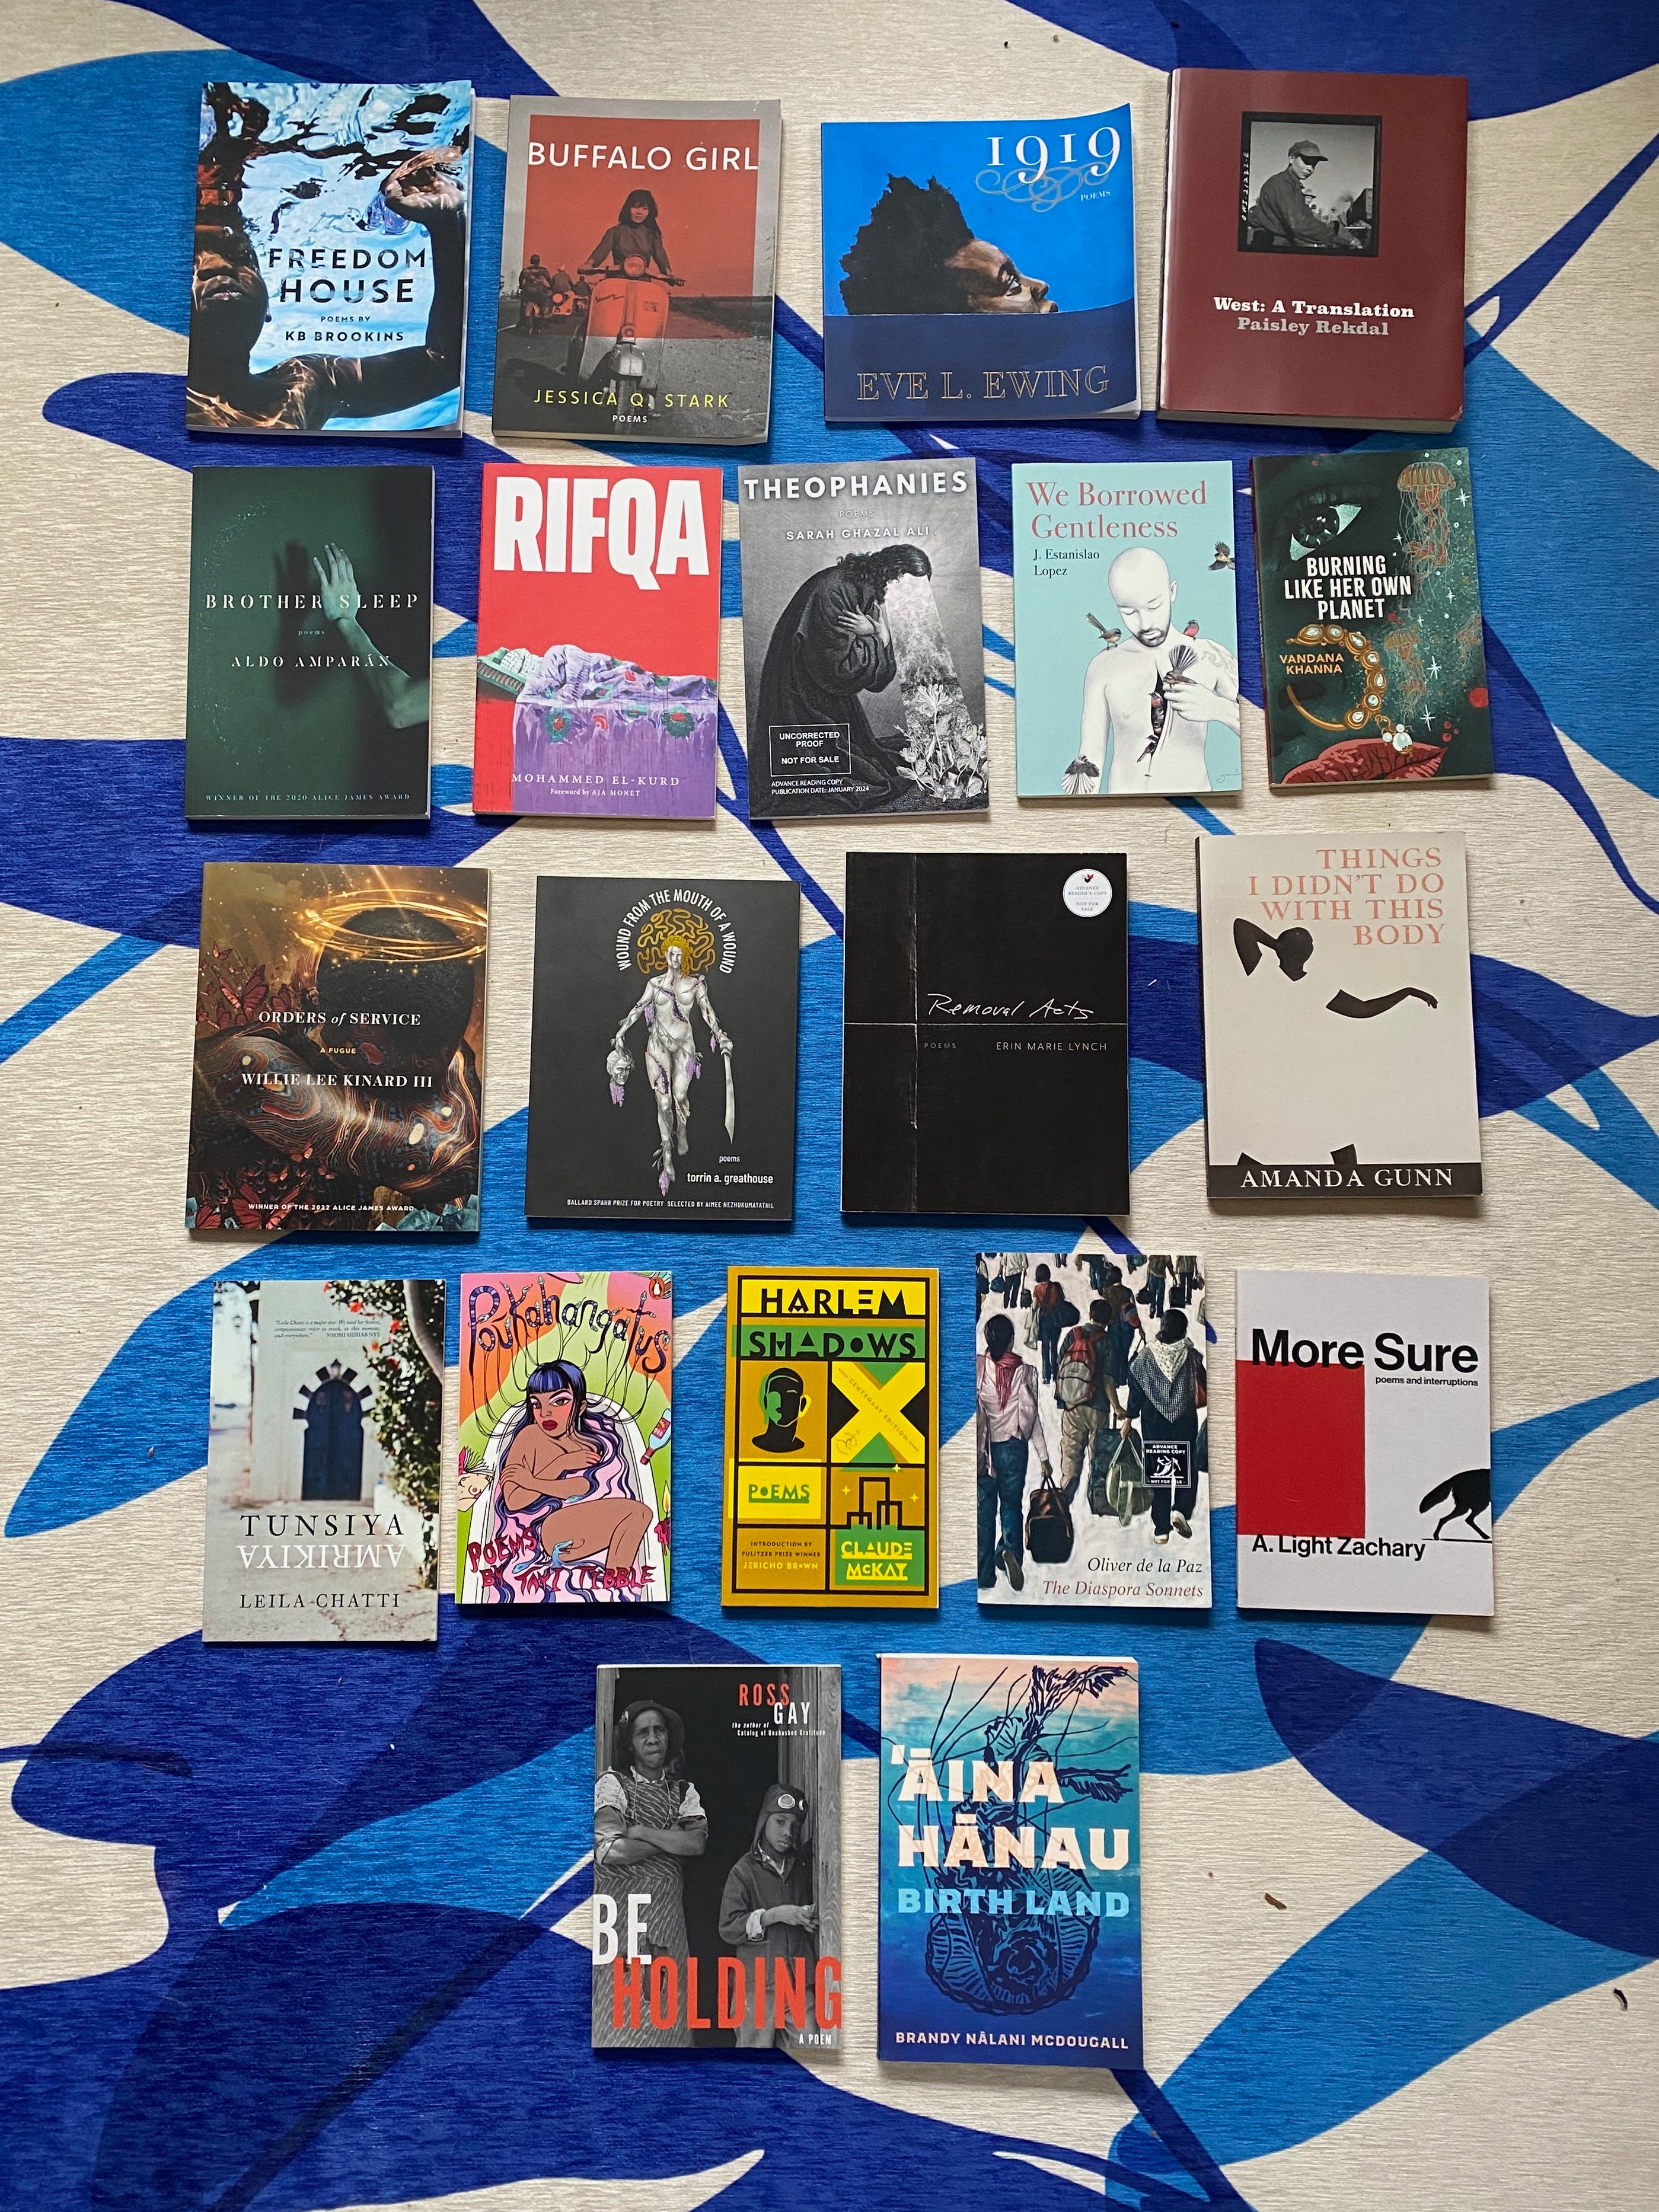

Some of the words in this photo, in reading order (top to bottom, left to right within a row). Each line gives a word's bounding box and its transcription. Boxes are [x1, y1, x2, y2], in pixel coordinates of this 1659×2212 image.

[528, 142, 671, 170] BUFFALO
[686, 146, 758, 170] GIRL
[987, 126, 1121, 184] 1919
[269, 247, 426, 270] FREEDOM
[280, 279, 413, 304] HOUSE
[1214, 297, 1265, 312] West:
[1272, 300, 1285, 313] A
[1291, 301, 1414, 318] Translation
[285, 331, 306, 341] KB
[314, 331, 404, 342] BROOKINS
[1237, 317, 1310, 336] Paisley
[1316, 321, 1389, 336] Rekdal
[857, 372, 929, 400] EVE
[941, 372, 972, 399] L.
[984, 365, 1109, 398] EWING
[534, 390, 617, 405] JESSICA
[665, 394, 729, 407] STARK
[612, 414, 648, 423] POEMS
[744, 471, 968, 500] THEOPHANIES
[1026, 481, 1069, 506] We
[1079, 480, 1207, 506] Borrowed
[840, 510, 875, 518] POEMS
[493, 476, 710, 590] RIFQA
[786, 530, 834, 541] SARAH
[841, 528, 900, 540] GHAZAL
[907, 526, 929, 537] ALI
[1031, 513, 1178, 538] Gentleness
[1033, 550, 1042, 560] J.
[1045, 549, 1100, 560] Estanislao
[1034, 565, 1068, 578] Lopez
[1306, 555, 1386, 577] BURNING
[1284, 579, 1323, 599] LIKE
[1330, 578, 1366, 598] HER
[1371, 576, 1411, 596] OWN
[206, 594, 323, 609] BROTHER
[339, 593, 418, 608] SLEEP
[1317, 598, 1385, 620] PLANET
[231, 656, 284, 667] ALDO
[295, 653, 389, 667] AMPARÁN
[1280, 653, 1344, 664] VANDANA
[1286, 663, 1342, 675] KHANNA
[512, 773, 605, 785] MOHAMMED
[612, 775, 681, 786] EL-KURD
[582, 789, 590, 797] by
[1316, 847, 1442, 869] THINGS
[1249, 876, 1259, 895] I
[1398, 873, 1444, 893] DO
[649, 889, 671, 906] THE
[674, 889, 713, 911] MOUTH
[623, 899, 651, 927] FROM
[710, 906, 727, 922] OF
[1260, 901, 1352, 920] WITH
[1366, 898, 1444, 919] THIS
[718, 922, 732, 931] A
[1352, 924, 1446, 945] BODY
[615, 928, 631, 971] WOUND
[719, 931, 736, 973] WOUND
[927, 993, 1025, 1017] Removal
[1029, 998, 1094, 1020] Acts
[259, 1011, 326, 1024] ORDERS
[331, 1012, 347, 1027] of
[350, 1013, 421, 1026] SERVICE
[996, 1042, 1022, 1051] ERIN
[1027, 1042, 1064, 1051] MARIE
[1068, 1042, 1107, 1051] LYNCH
[241, 1073, 300, 1087] WILLIE
[305, 1074, 337, 1087] LEE
[343, 1074, 408, 1087] KINARD
[413, 1075, 432, 1088] III
[719, 1155, 740, 1163] poems
[687, 1173, 712, 1183] torrin
[724, 1174, 773, 1185] greathouse
[1240, 1169, 1366, 1189] AMANDA
[1374, 1168, 1453, 1187] GUNN
[761, 1288, 907, 1316] HARLEM
[749, 1331, 915, 1359] SHADOWS
[1252, 1329, 1364, 1370] More
[1374, 1333, 1478, 1373] Sure
[1376, 1375, 1404, 1386] poems
[1406, 1377, 1422, 1385] and
[1424, 1377, 1478, 1387] interruptions
[749, 1484, 810, 1503] POEMS
[240, 1514, 404, 1537] TUNSIYA
[467, 1528, 540, 1572] POEMS
[841, 1541, 912, 1560] CLAUDE
[1252, 1534, 1274, 1552] A.
[1278, 1535, 1332, 1558] Light
[1337, 1536, 1425, 1562] Zachary
[846, 1563, 908, 1581] McKAY
[1087, 1557, 1131, 1572] Oliver
[1136, 1557, 1153, 1572] de
[1159, 1557, 1170, 1573] la
[1176, 1559, 1202, 1574] Paz
[480, 1565, 503, 1588] BY
[514, 1567, 563, 1596] TAYI
[575, 1565, 656, 1591] TIBBLE
[1042, 1580, 1070, 1595] The
[1074, 1581, 1141, 1598] Diaspora
[1146, 1582, 1203, 1597] Sonnets
[240, 1594, 305, 1609] LEILA
[316, 1593, 400, 1608] CHATTI
[739, 1683, 790, 1706] ROSS
[773, 1702, 811, 1725] GAY
[898, 1814, 1130, 1871] HĀNAU
[898, 1888, 1013, 1914] BIRTH
[1026, 1889, 1130, 1918] LAND
[592, 1894, 652, 1965] BE
[612, 1956, 842, 2029] HOLDING
[896, 2031, 960, 2044] BRANDY
[1032, 2035, 1128, 2050] MCDOUGALL
